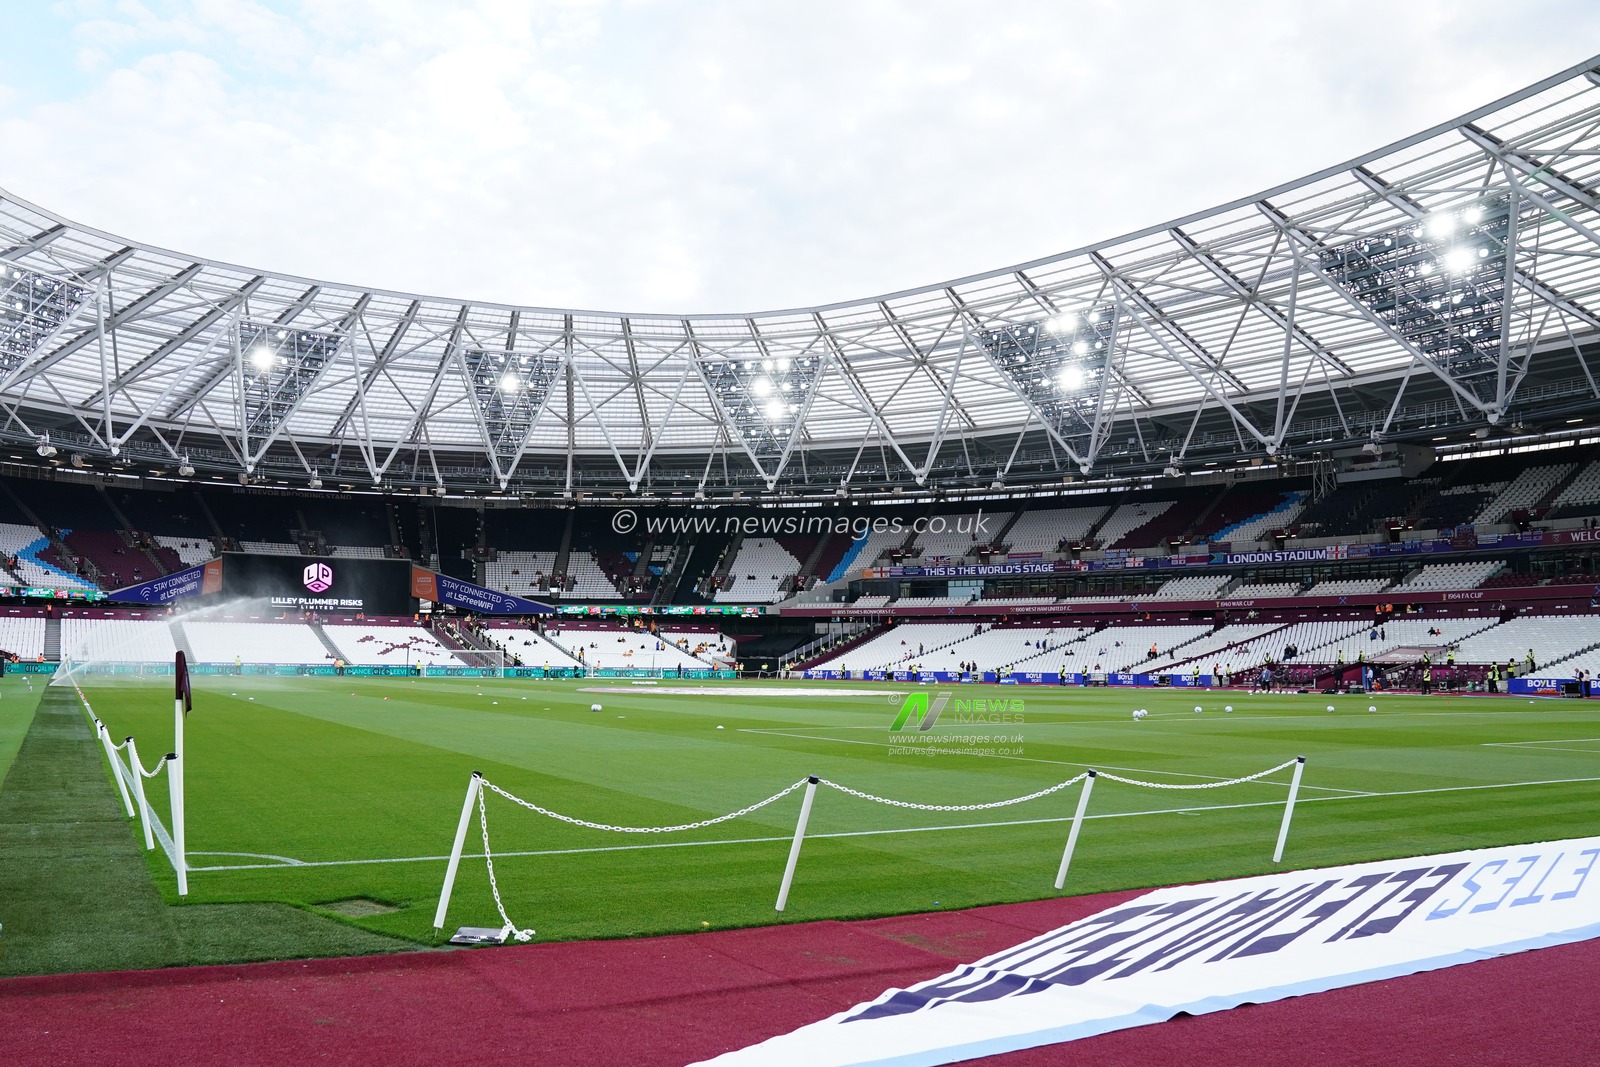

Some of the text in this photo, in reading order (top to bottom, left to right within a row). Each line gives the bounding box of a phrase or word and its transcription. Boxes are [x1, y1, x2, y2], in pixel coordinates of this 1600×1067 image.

[1226, 549, 1326, 565] LONDON STADIUM
[923, 566, 945, 577] THIS
[946, 566, 956, 576] IS
[957, 566, 977, 576] THE
[977, 564, 1022, 575] WORLD'S
[1022, 563, 1055, 574] STAGE
[153, 570, 201, 593] STAY CONNECTED
[159, 593, 167, 601] at
[441, 579, 503, 604] STAY CONNECTED
[445, 590, 454, 599] at
[271, 596, 363, 607] LILLEY PLUMMER RISKS
[515, 669, 533, 677] arc
[1527, 679, 1557, 688] BOYLE
